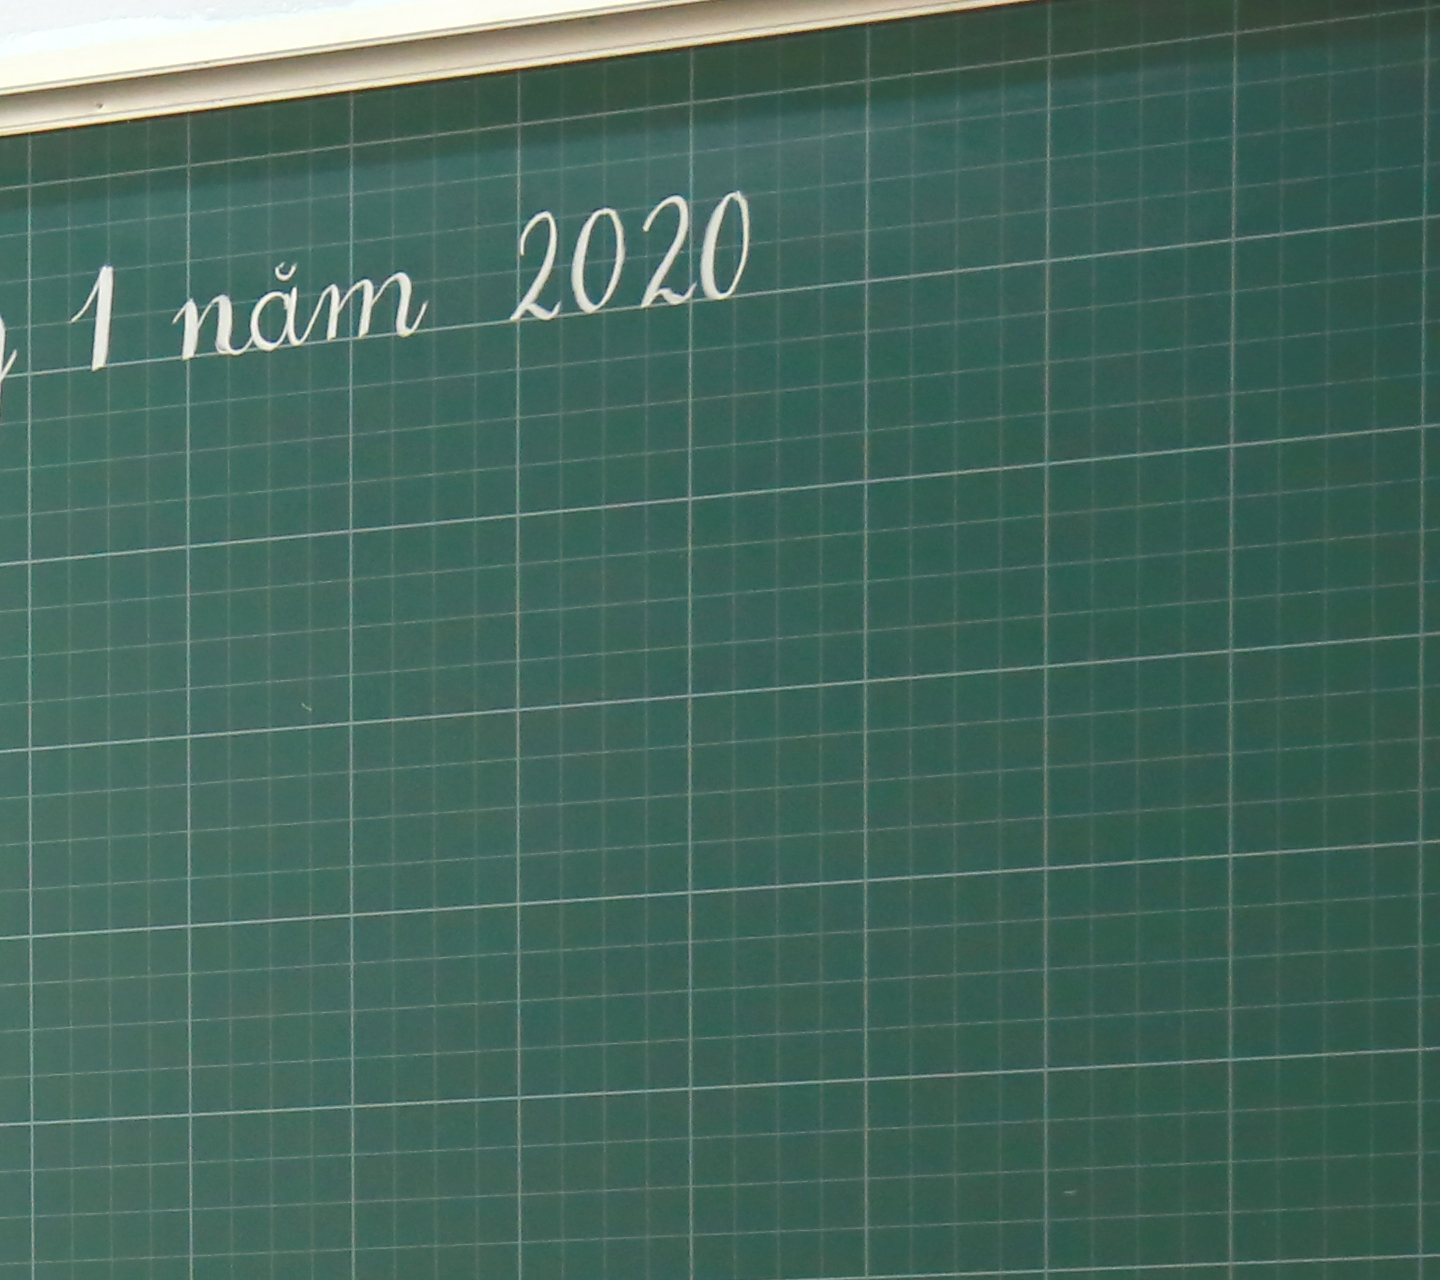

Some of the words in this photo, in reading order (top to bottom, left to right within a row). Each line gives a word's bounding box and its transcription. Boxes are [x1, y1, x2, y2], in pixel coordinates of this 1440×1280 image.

[71, 264, 115, 371] 1
[172, 259, 427, 361] năm
[510, 190, 752, 322] 2020
